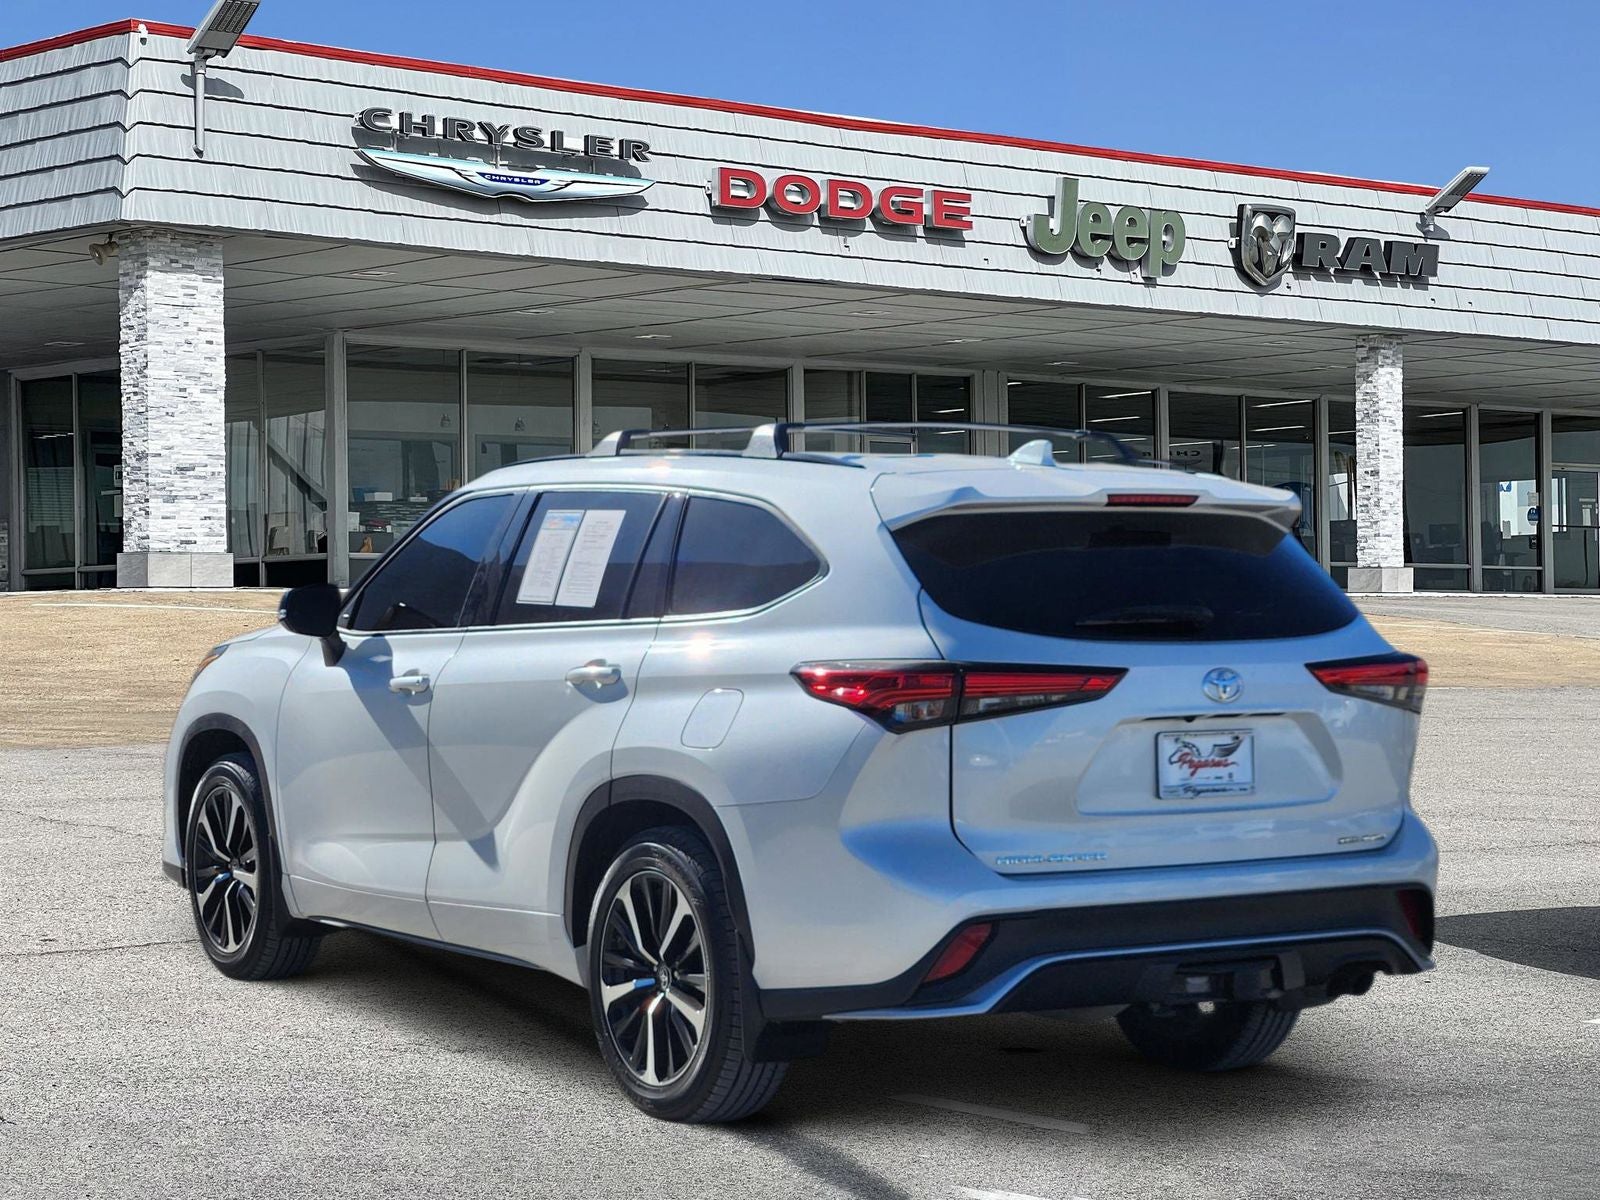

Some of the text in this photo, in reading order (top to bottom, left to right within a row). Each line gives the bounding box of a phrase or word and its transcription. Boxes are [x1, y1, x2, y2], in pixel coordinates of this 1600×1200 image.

[358, 106, 651, 162] CHRYSLER
[484, 174, 541, 185] CHRYSLER
[712, 166, 974, 231] DODGE
[1028, 176, 1186, 279] Jeep
[1299, 232, 1440, 278] RAM
